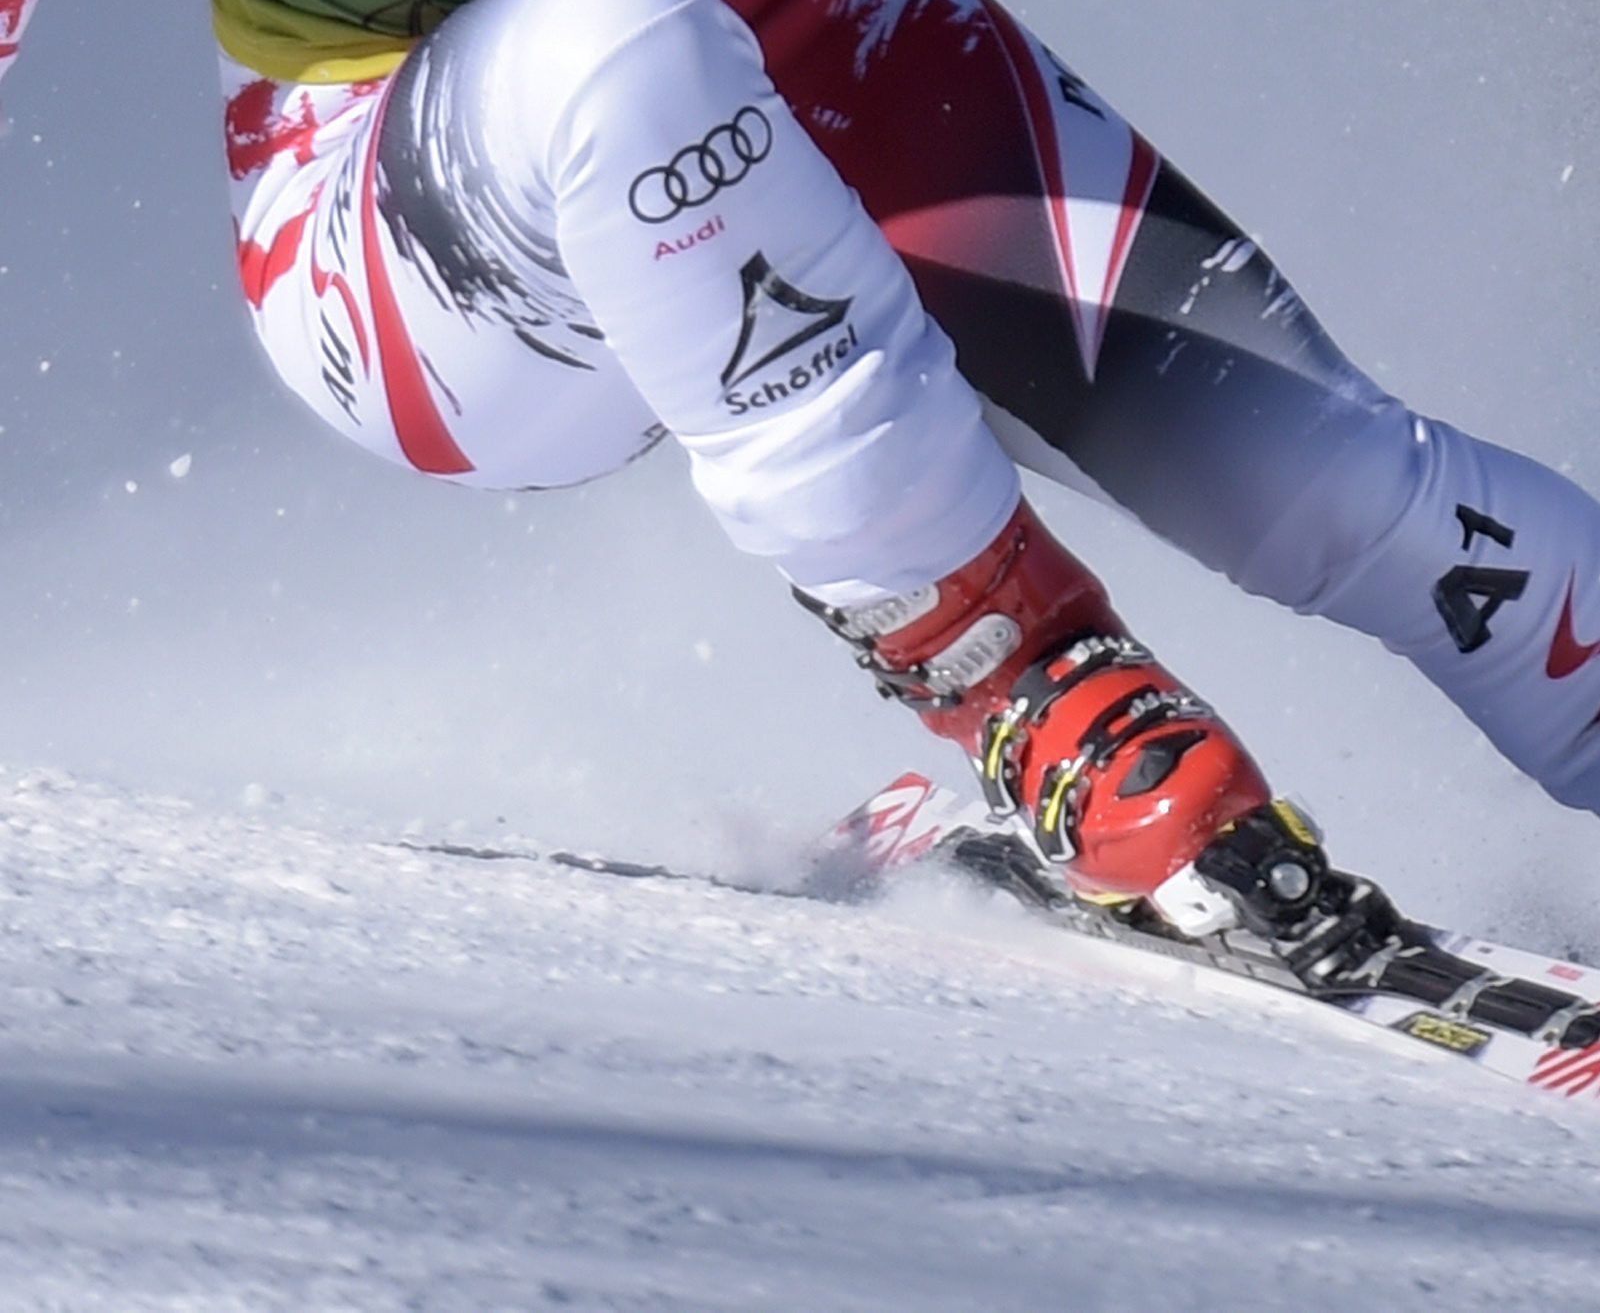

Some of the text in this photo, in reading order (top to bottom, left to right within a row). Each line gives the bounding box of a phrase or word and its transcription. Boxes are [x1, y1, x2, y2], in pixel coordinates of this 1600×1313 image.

[653, 214, 726, 261] Audi
[724, 323, 859, 417] Schöffel
[1430, 503, 1531, 654] A1
